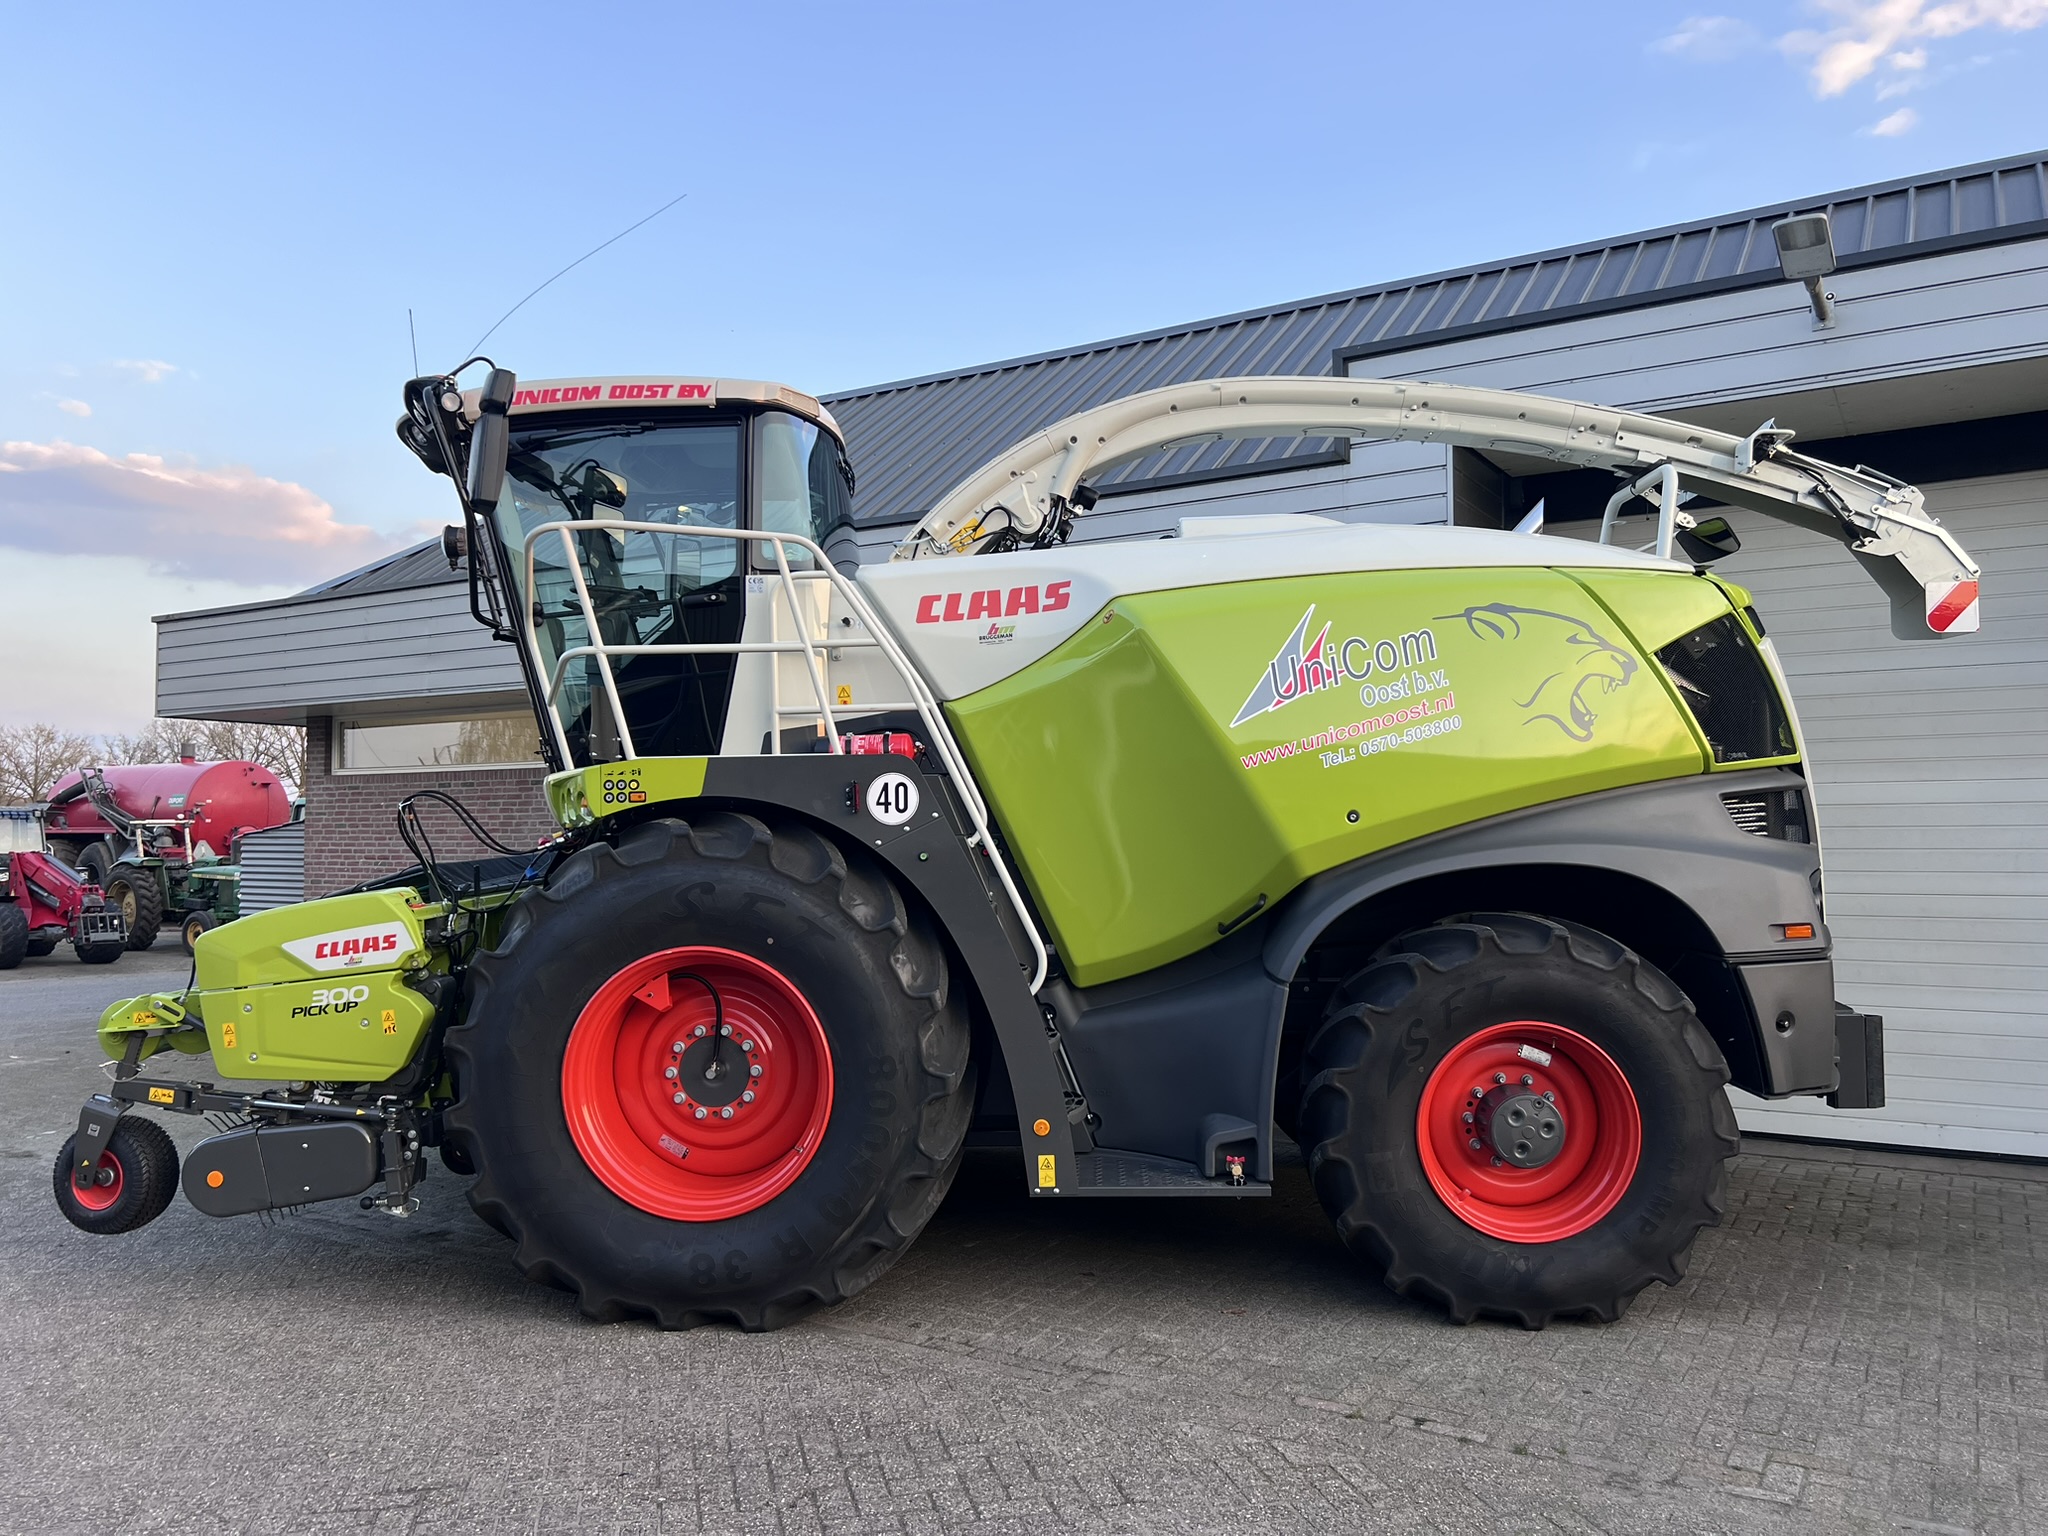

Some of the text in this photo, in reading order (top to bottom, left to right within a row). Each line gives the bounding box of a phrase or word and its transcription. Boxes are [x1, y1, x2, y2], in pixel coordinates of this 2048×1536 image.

[608, 384, 674, 399] OOST
[677, 384, 712, 398] BV
[915, 580, 1072, 624] CLAAS
[1269, 628, 1437, 701] UniCom
[1360, 669, 1449, 707] Oost b.v.
[1241, 691, 1455, 769] www.unicomoost.nl
[1319, 715, 1462, 768] Tel.: 0570-503800
[876, 782, 908, 813] 40
[315, 933, 397, 960] CLAAS
[291, 1001, 359, 1018] PICK UP
[311, 985, 369, 1007] 300
